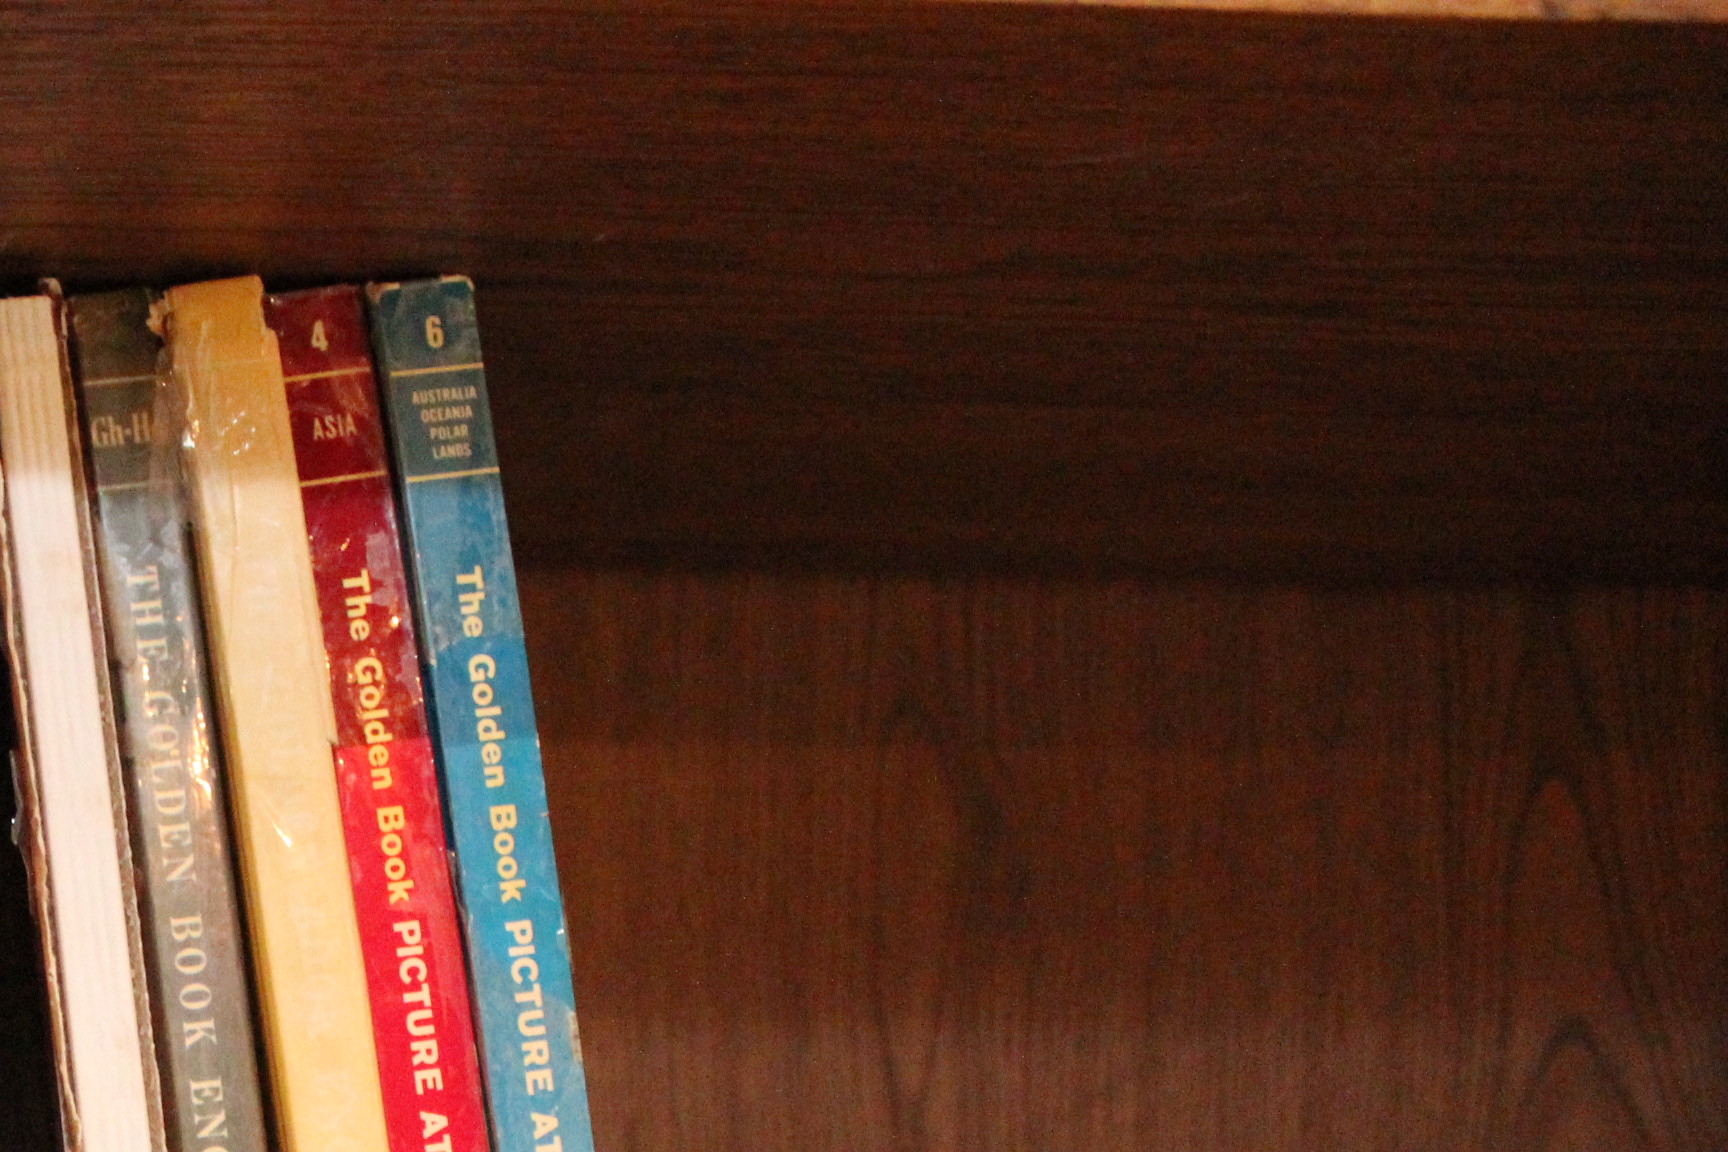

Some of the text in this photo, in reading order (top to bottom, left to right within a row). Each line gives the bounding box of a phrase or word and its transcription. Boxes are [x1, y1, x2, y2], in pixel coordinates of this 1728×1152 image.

[311, 320, 329, 351] 4
[425, 315, 445, 348] 6
[313, 414, 357, 441] ASIA
[412, 385, 478, 405] AUSTRALIA
[421, 405, 473, 423] OCEANIA
[429, 424, 469, 440] POLAR
[433, 442, 472, 459] LANDS
[128, 565, 168, 664] THE
[342, 569, 372, 642] The
[456, 565, 483, 638] The
[348, 656, 393, 790] Golden
[467, 653, 505, 788] Golden
[145, 690, 196, 882] GOLDEN
[376, 805, 415, 905] Book
[489, 804, 527, 904] Book
[170, 913, 217, 1049] BOOK
[393, 920, 444, 1096] PICTURE
[504, 919, 554, 1096] PICTURE
